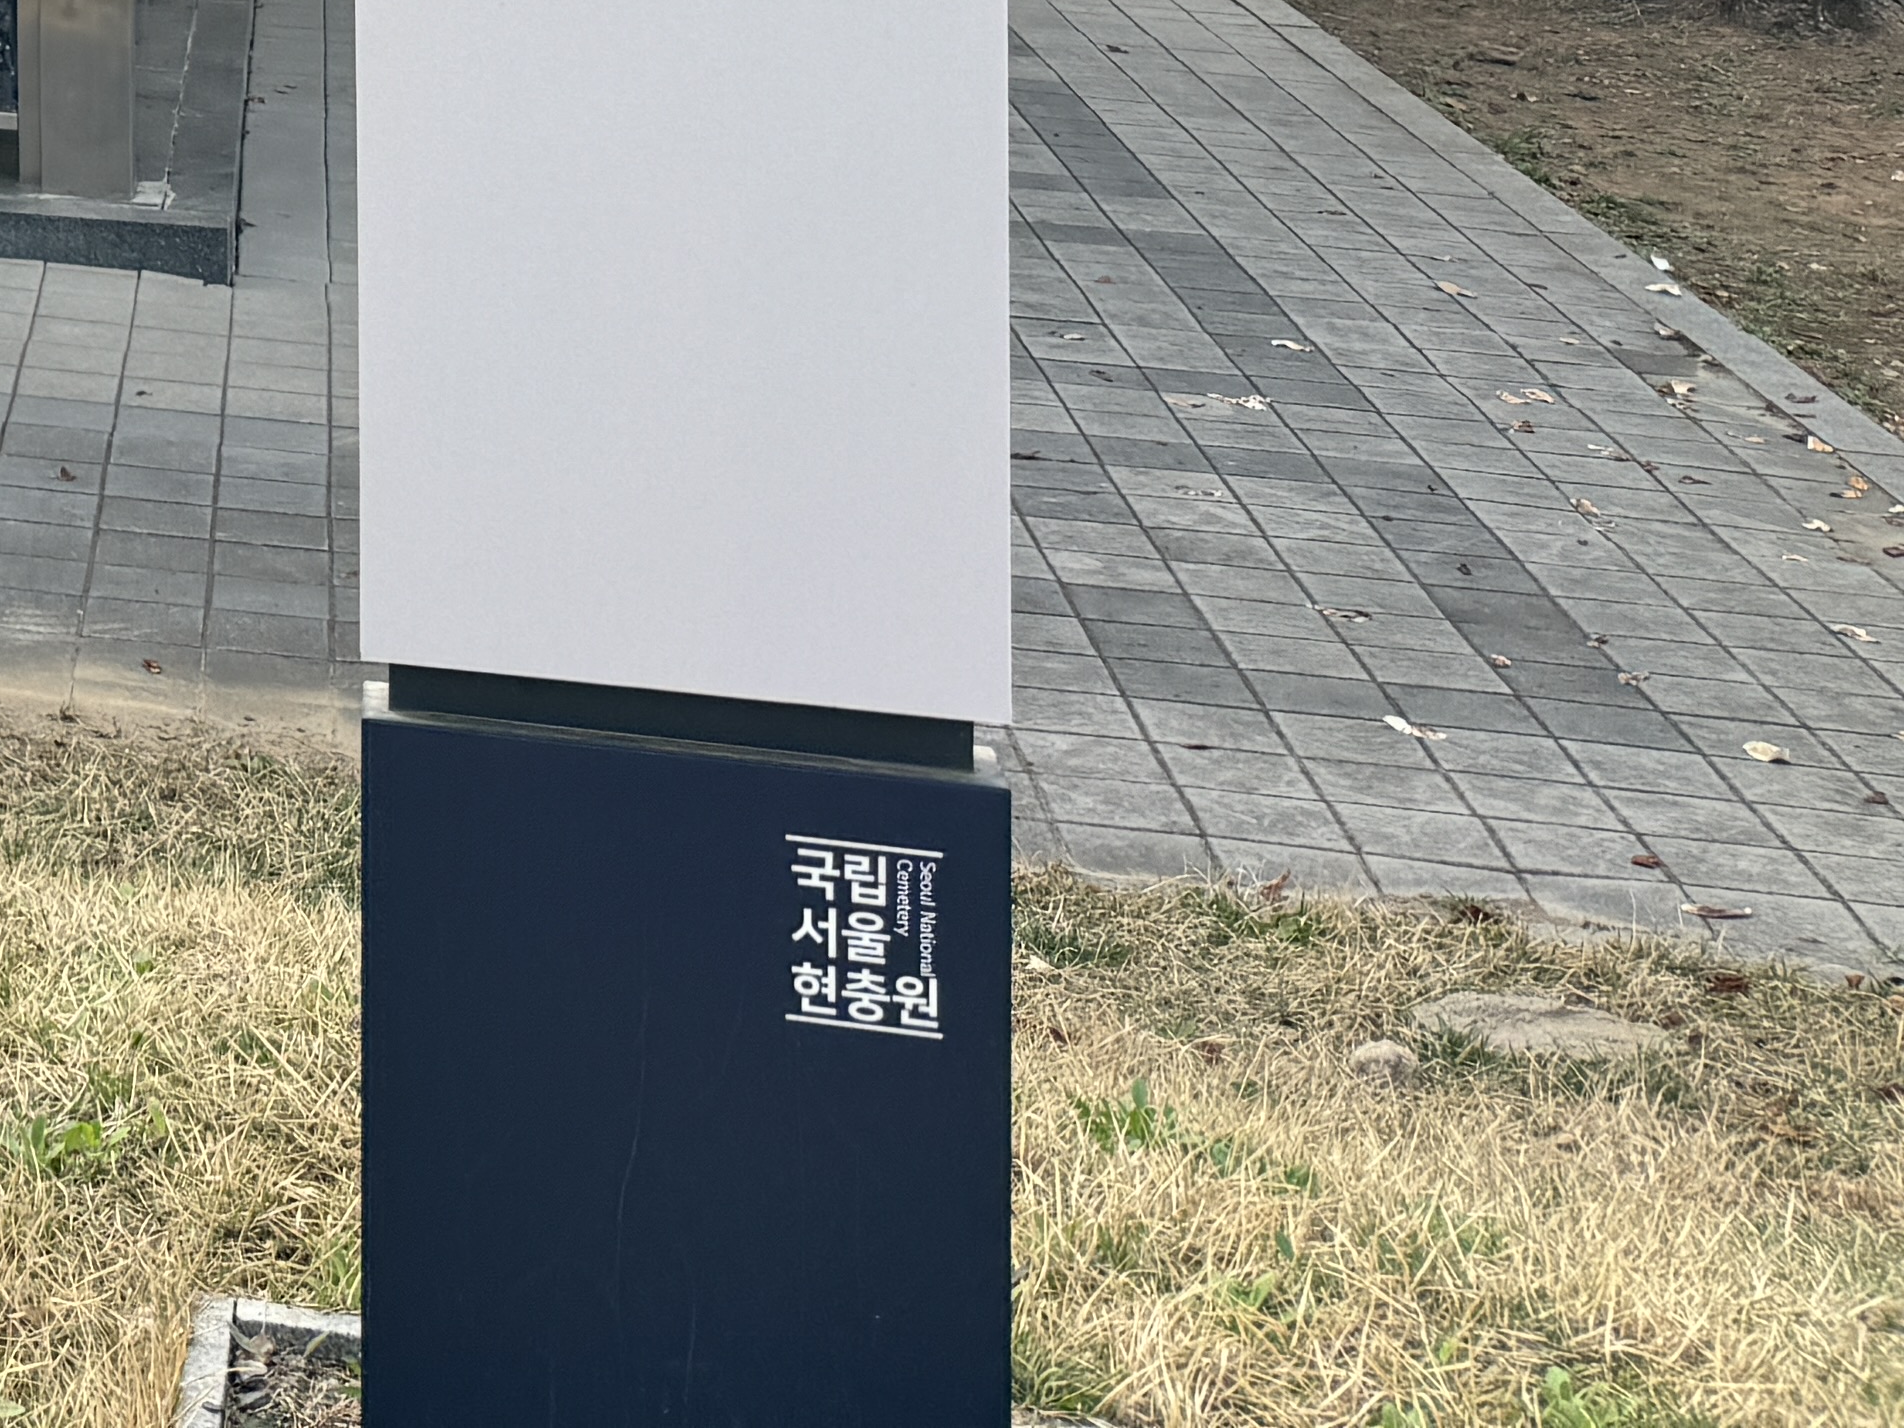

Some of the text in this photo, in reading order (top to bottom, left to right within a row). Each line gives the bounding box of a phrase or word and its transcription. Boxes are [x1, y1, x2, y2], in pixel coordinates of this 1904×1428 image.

[791, 848, 887, 907] 국립
[893, 859, 912, 936] Cemetery
[792, 908, 891, 965] 서울
[920, 862, 937, 978] Seoul National
[791, 962, 938, 1028] 현충원
